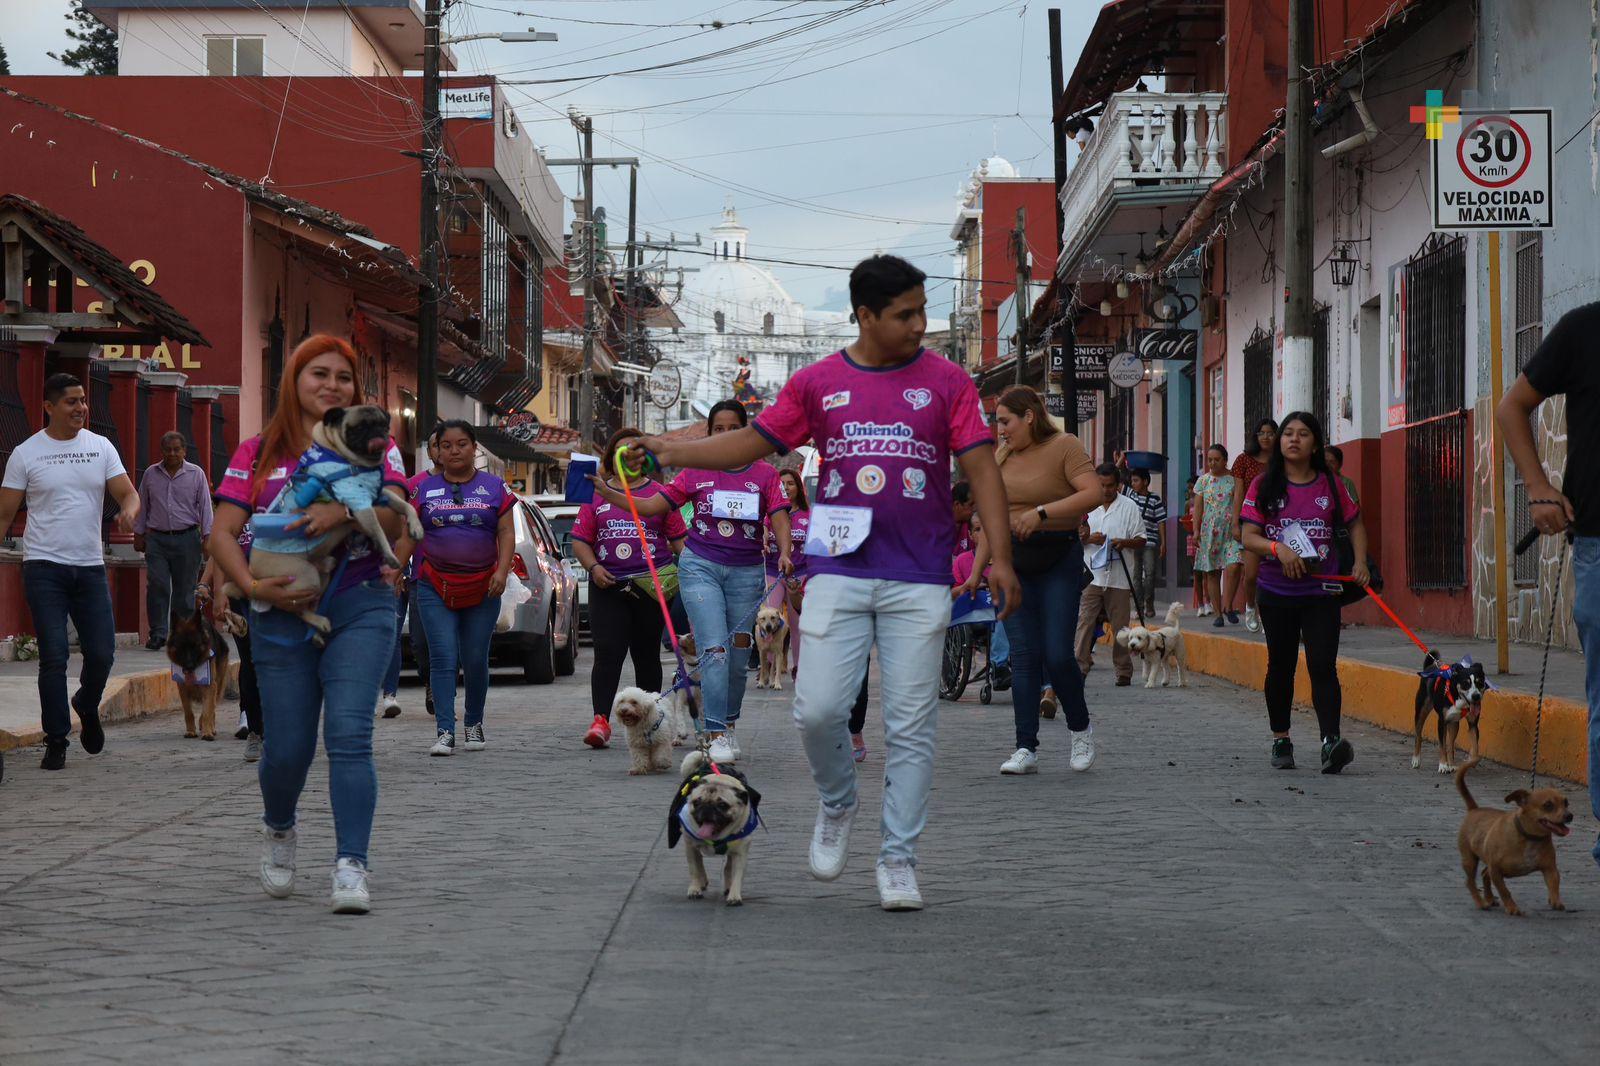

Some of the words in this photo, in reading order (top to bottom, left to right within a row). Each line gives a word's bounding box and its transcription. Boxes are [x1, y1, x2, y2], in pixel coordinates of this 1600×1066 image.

[446, 92, 490, 103] MetLife
[1470, 129, 1518, 163] 30
[1479, 165, 1508, 176] Km/h
[1443, 190, 1545, 206] VELOCIDAD
[1458, 204, 1531, 222] MÁXIMA
[1053, 346, 1104, 355] TCNICO
[1053, 355, 1104, 366] DNTAL
[1113, 371, 1141, 381] MÉDICO
[843, 421, 913, 437] Uniendo
[825, 438, 937, 463] Corazones
[36, 453, 85, 461] AEROPOSTALE
[727, 501, 743, 509] 021
[829, 524, 850, 539] 012
